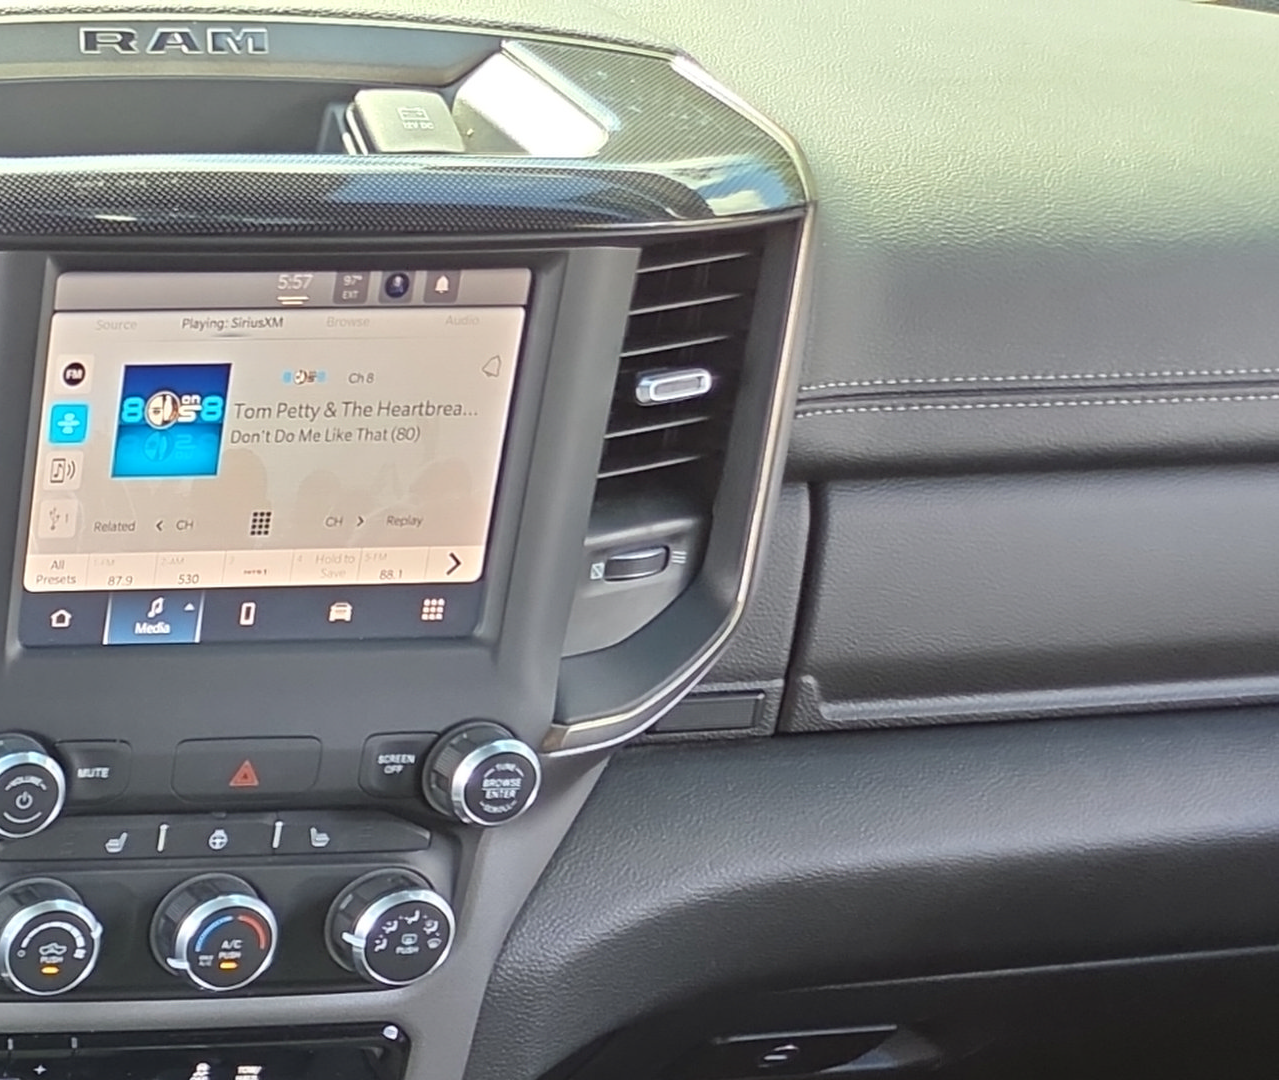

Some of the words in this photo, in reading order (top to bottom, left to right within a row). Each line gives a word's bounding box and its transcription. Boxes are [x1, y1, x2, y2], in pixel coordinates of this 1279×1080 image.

[79, 27, 269, 55] RAM
[277, 274, 313, 290] 5:57
[343, 290, 359, 299] EXT
[96, 320, 138, 330] Source
[182, 318, 228, 331] Playing:
[231, 317, 284, 328] SiriusXM
[327, 317, 370, 328] Browse
[445, 315, 480, 326] Audio
[66, 369, 83, 380] FM
[348, 373, 364, 384] Ch
[366, 374, 374, 384] 8
[234, 403, 271, 419] Tom
[277, 402, 319, 422] Petty
[324, 403, 337, 418] &
[342, 401, 372, 417] The
[230, 430, 270, 444] Don't
[274, 429, 294, 443] Do
[298, 428, 320, 442] Me
[325, 427, 352, 442] Like
[357, 426, 387, 442] That
[391, 425, 421, 443] (80)
[94, 520, 136, 532] Related
[176, 519, 194, 531] CH
[326, 517, 344, 527] CH
[387, 515, 424, 528] Replay
[316, 553, 342, 564] Hold
[345, 554, 355, 564] to
[50, 560, 65, 570] All
[321, 568, 346, 578] Save
[380, 570, 403, 580] 88.1
[36, 575, 76, 585] Presets
[107, 576, 133, 586] 87.9
[178, 574, 200, 584] 530
[135, 622, 170, 634] Media
[378, 754, 415, 765] SCREEN
[77, 767, 110, 779] MUTE
[384, 765, 403, 774] OFF
[482, 778, 522, 788] BROWSE
[485, 789, 516, 799] ENTER
[221, 939, 242, 949] A/C
